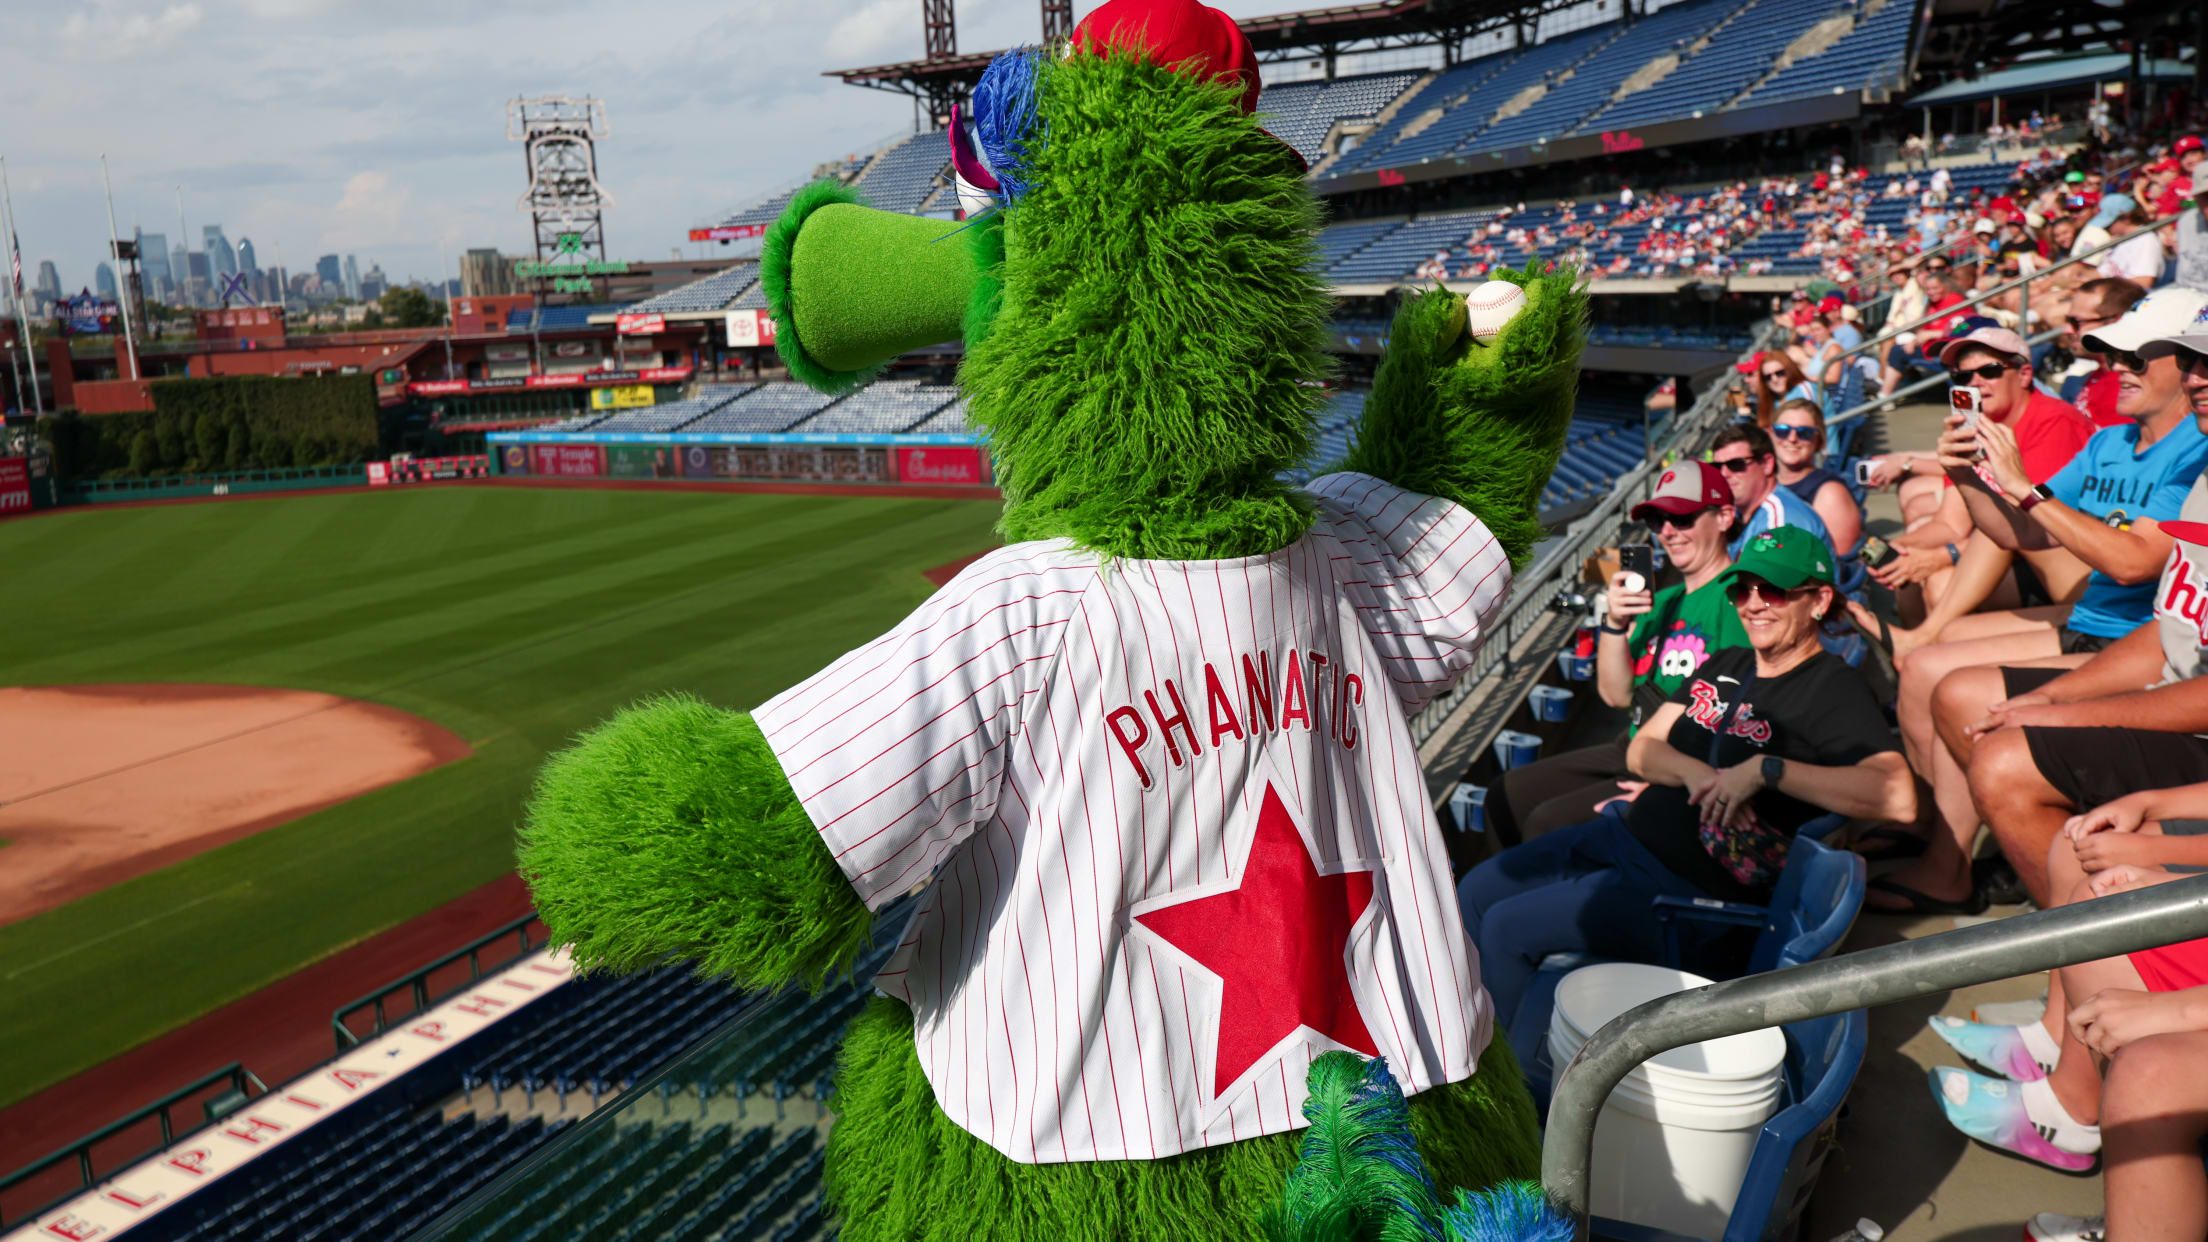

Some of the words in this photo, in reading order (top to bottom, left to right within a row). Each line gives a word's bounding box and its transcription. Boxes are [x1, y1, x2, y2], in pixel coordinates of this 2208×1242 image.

[515, 260, 584, 277] Citizens
[586, 258, 629, 274] Bank
[554, 276, 593, 293] Park
[559, 446, 595, 462] Temple
[1656, 471, 1676, 493] P
[1106, 648, 1364, 789] PHANATIC
